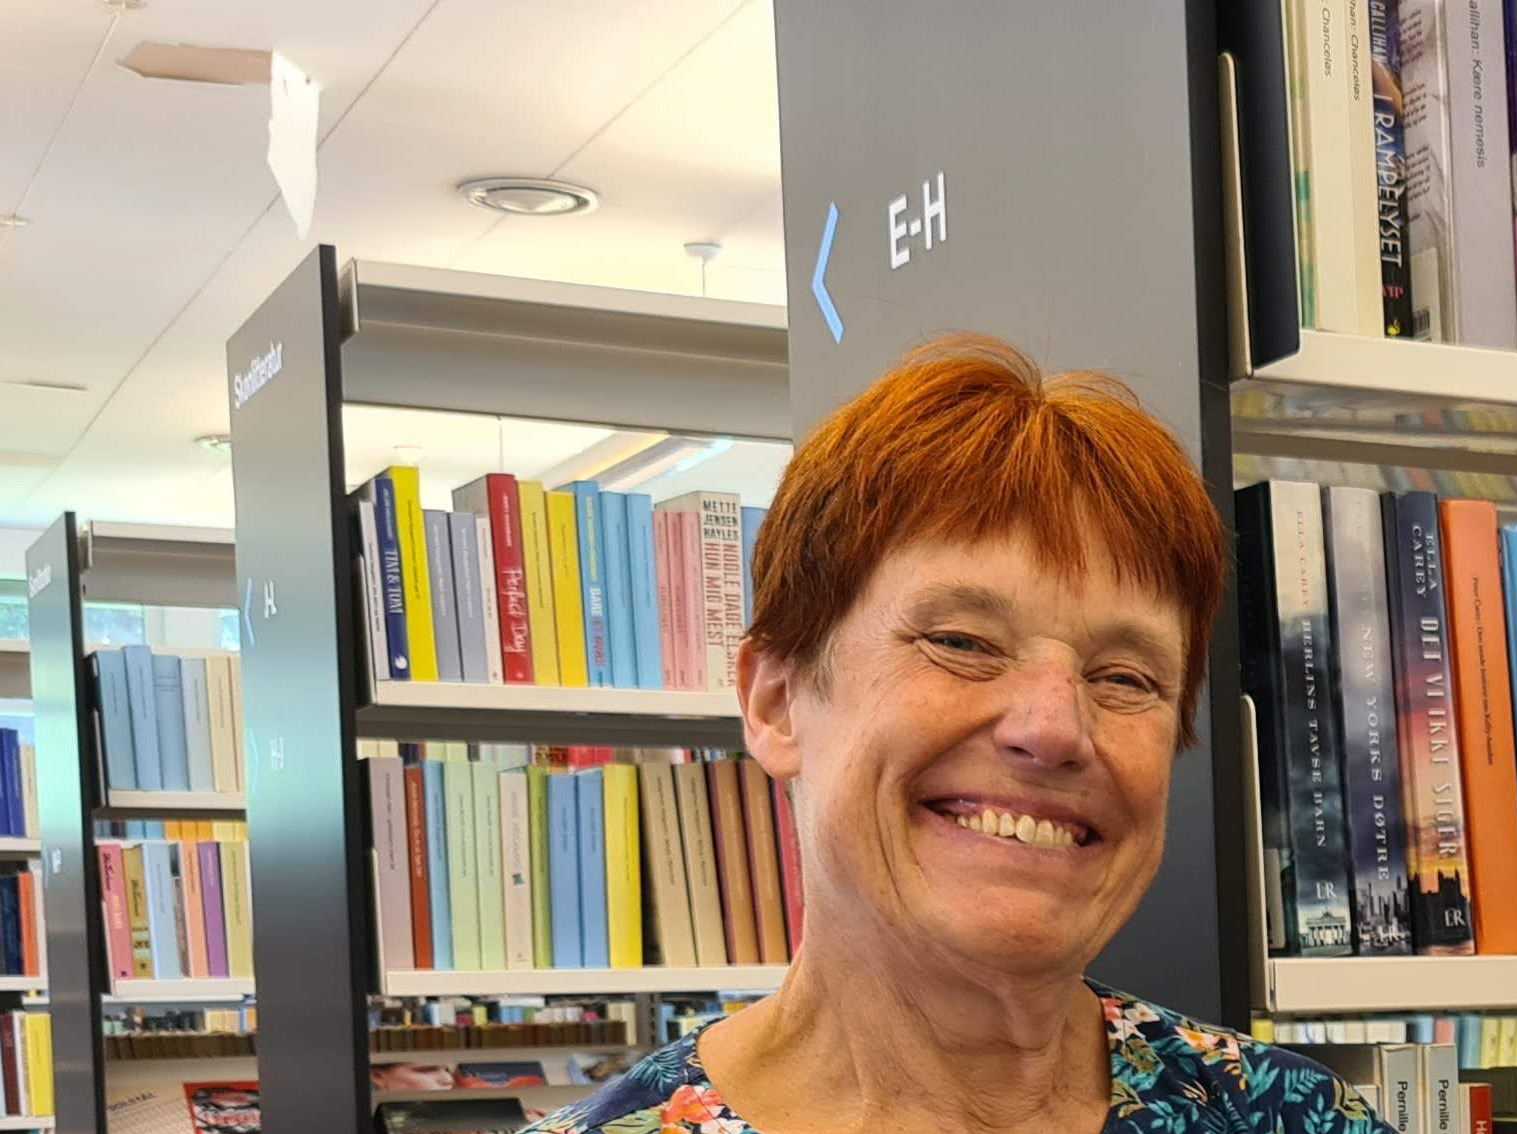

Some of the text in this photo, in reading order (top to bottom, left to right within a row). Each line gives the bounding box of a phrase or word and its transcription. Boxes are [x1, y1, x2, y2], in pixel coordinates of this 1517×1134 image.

[1469, 0, 1488, 168] allihan: Kære nemesis
[888, 171, 947, 270] E-H
[1374, 111, 1403, 268] RAMPELYSET
[702, 500, 737, 514] METTE
[703, 514, 738, 528] JENSEN
[704, 542, 724, 648] HUN MIG MEST
[722, 544, 741, 588] NOGLE
[1412, 525, 1428, 598] CAREY
[1425, 534, 1438, 590] ELLA
[502, 567, 528, 654] Perfect Day
[724, 593, 743, 630] DAGE
[1302, 620, 1318, 711] BERLINS
[1308, 719, 1323, 784] TAVSE
[1361, 624, 1390, 881] NEW YORKS DØTRE
[1420, 616, 1458, 858] DET VI IKKE SIGER
[1314, 791, 1328, 848] BARN
[1397, 1080, 1409, 1132] Pernille
[1438, 1079, 1451, 1131] Pernille
